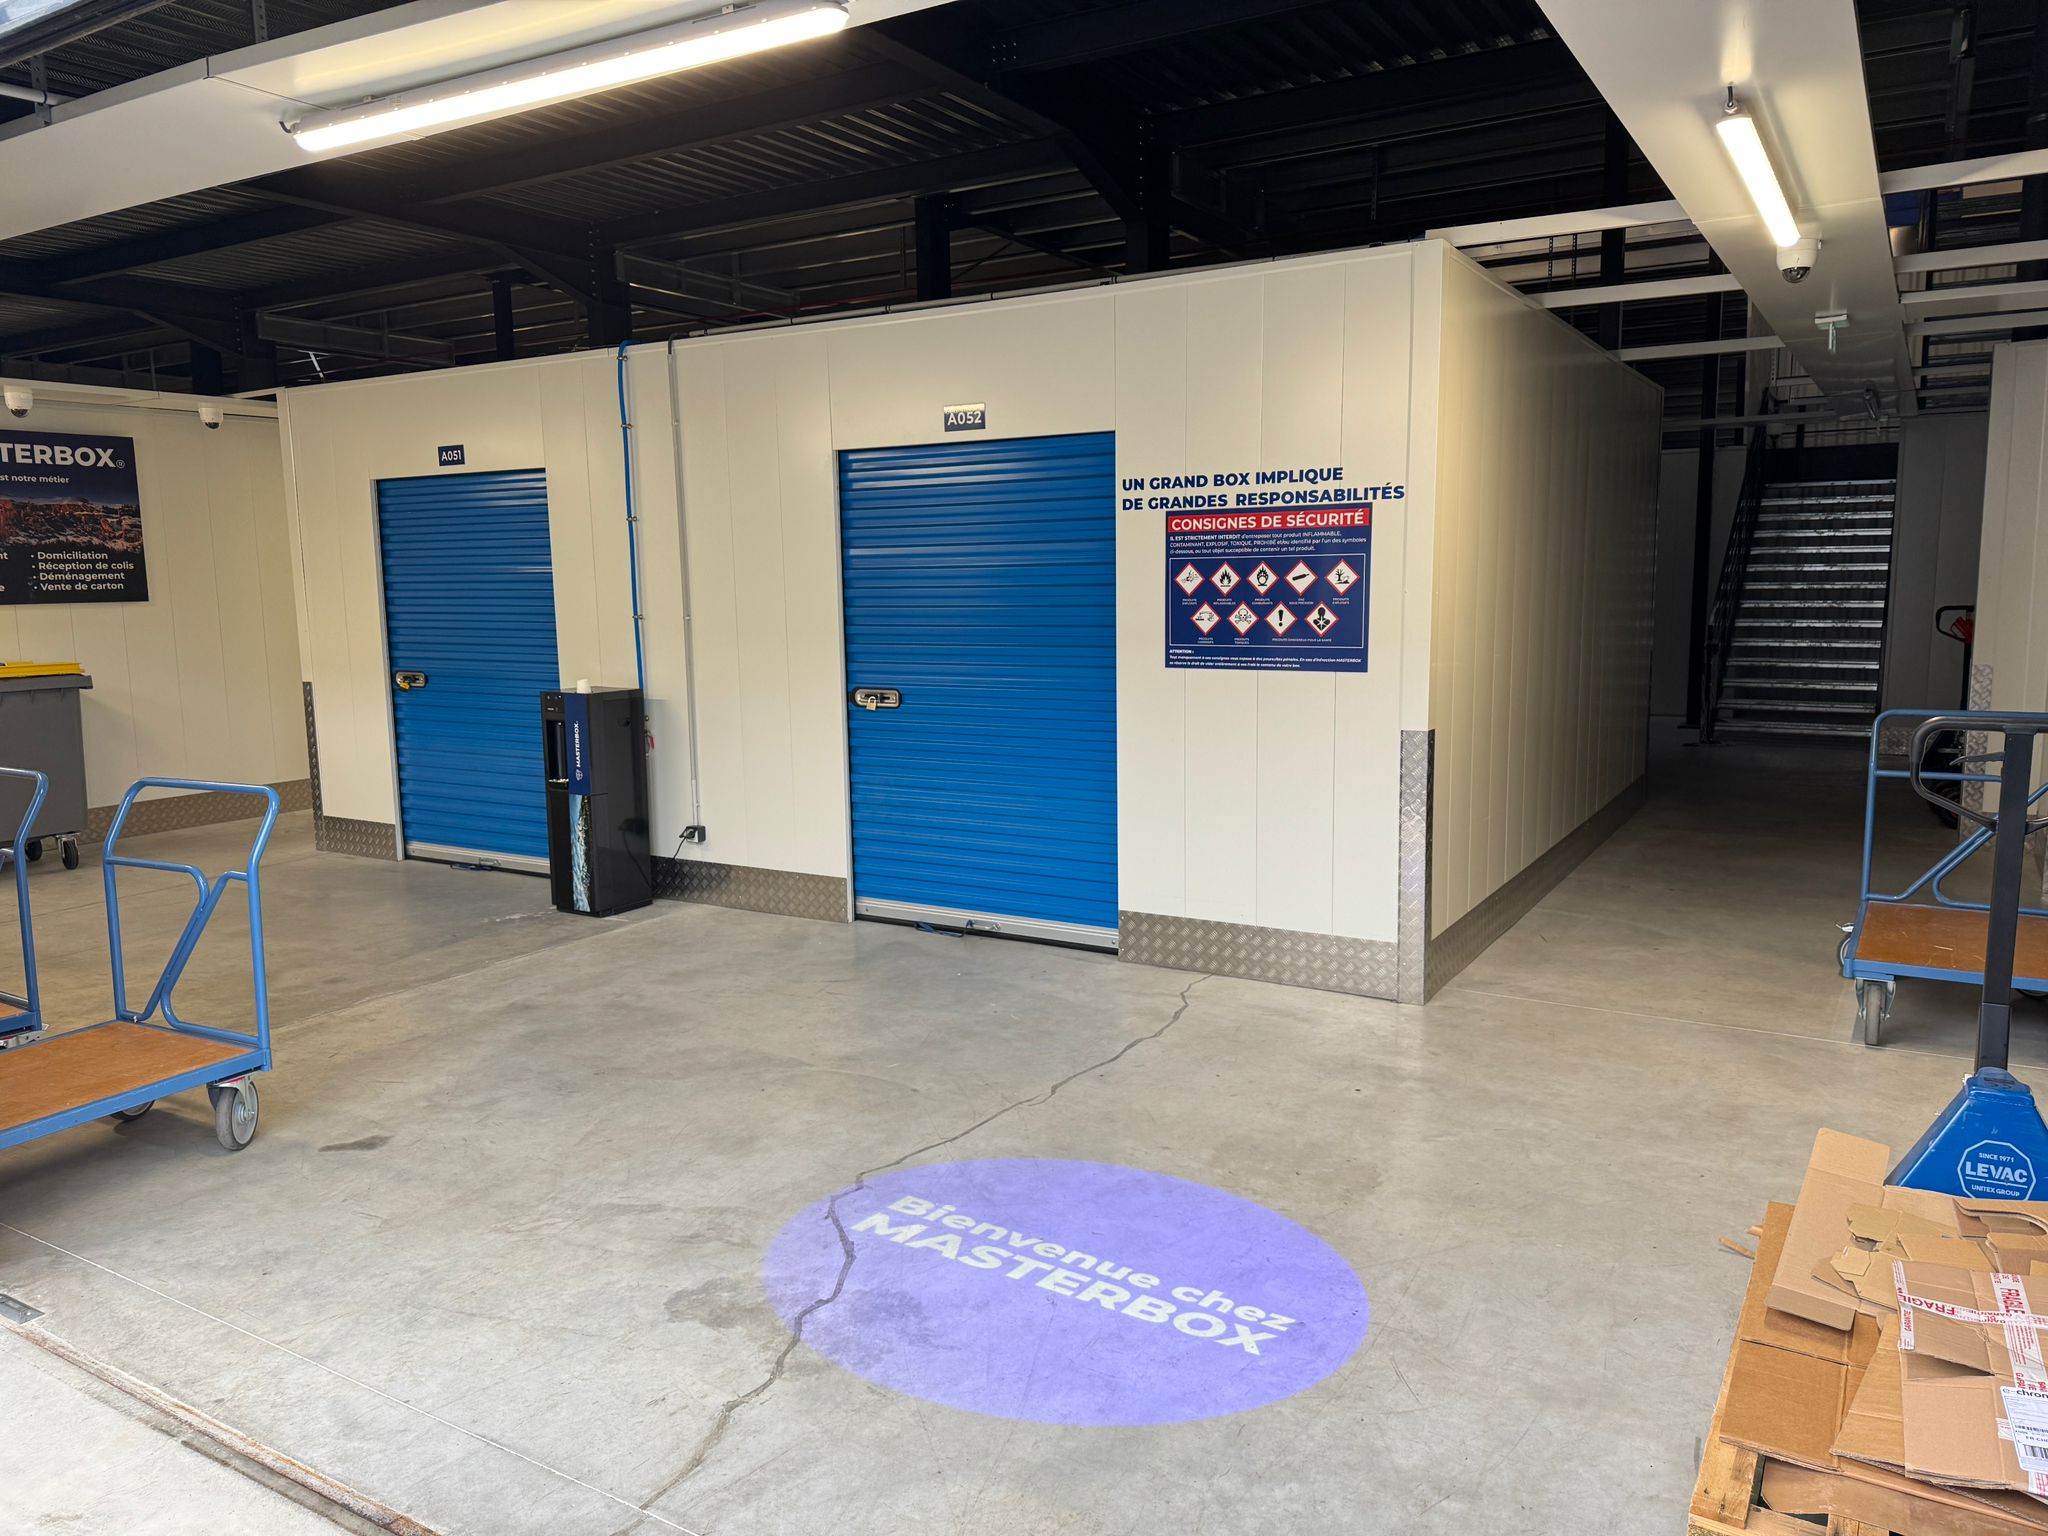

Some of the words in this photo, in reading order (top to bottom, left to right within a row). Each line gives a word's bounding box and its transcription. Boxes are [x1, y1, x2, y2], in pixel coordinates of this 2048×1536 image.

[947, 411, 982, 426] A052
[441, 450, 462, 461] A051
[40, 475, 70, 484] métier
[1122, 478, 1145, 491] UN
[1149, 474, 1209, 490] GRAND
[1213, 472, 1250, 487] BOX
[1256, 467, 1344, 485] IMPLIQUE
[1122, 498, 1144, 511] DE
[1148, 494, 1228, 510] GRANDES
[1235, 482, 1405, 506] RESPONSABILITÉS
[1171, 516, 1257, 531] CONSIGNES
[1261, 515, 1282, 528] DE
[1286, 509, 1364, 527] SÉCURITÉ
[37, 551, 109, 560] Domiciliation
[39, 561, 93, 571] Réception
[95, 561, 109, 570] de
[111, 561, 135, 570] colis
[40, 572, 126, 581] Déménagement
[40, 582, 72, 591] Vente
[75, 582, 88, 590] de
[91, 582, 124, 590] carton
[1979, 1152, 1998, 1160] SINCE
[1999, 1155, 2014, 1163] 1971
[1965, 1161, 2028, 1183] LEVAC
[1971, 1184, 1995, 1194] UNITEX
[1995, 1188, 2020, 1197] GROUP
[887, 1195, 1161, 1289] Bienvenue
[1171, 1286, 1297, 1332] chez
[850, 1212, 1278, 1356] MASTERBOX
